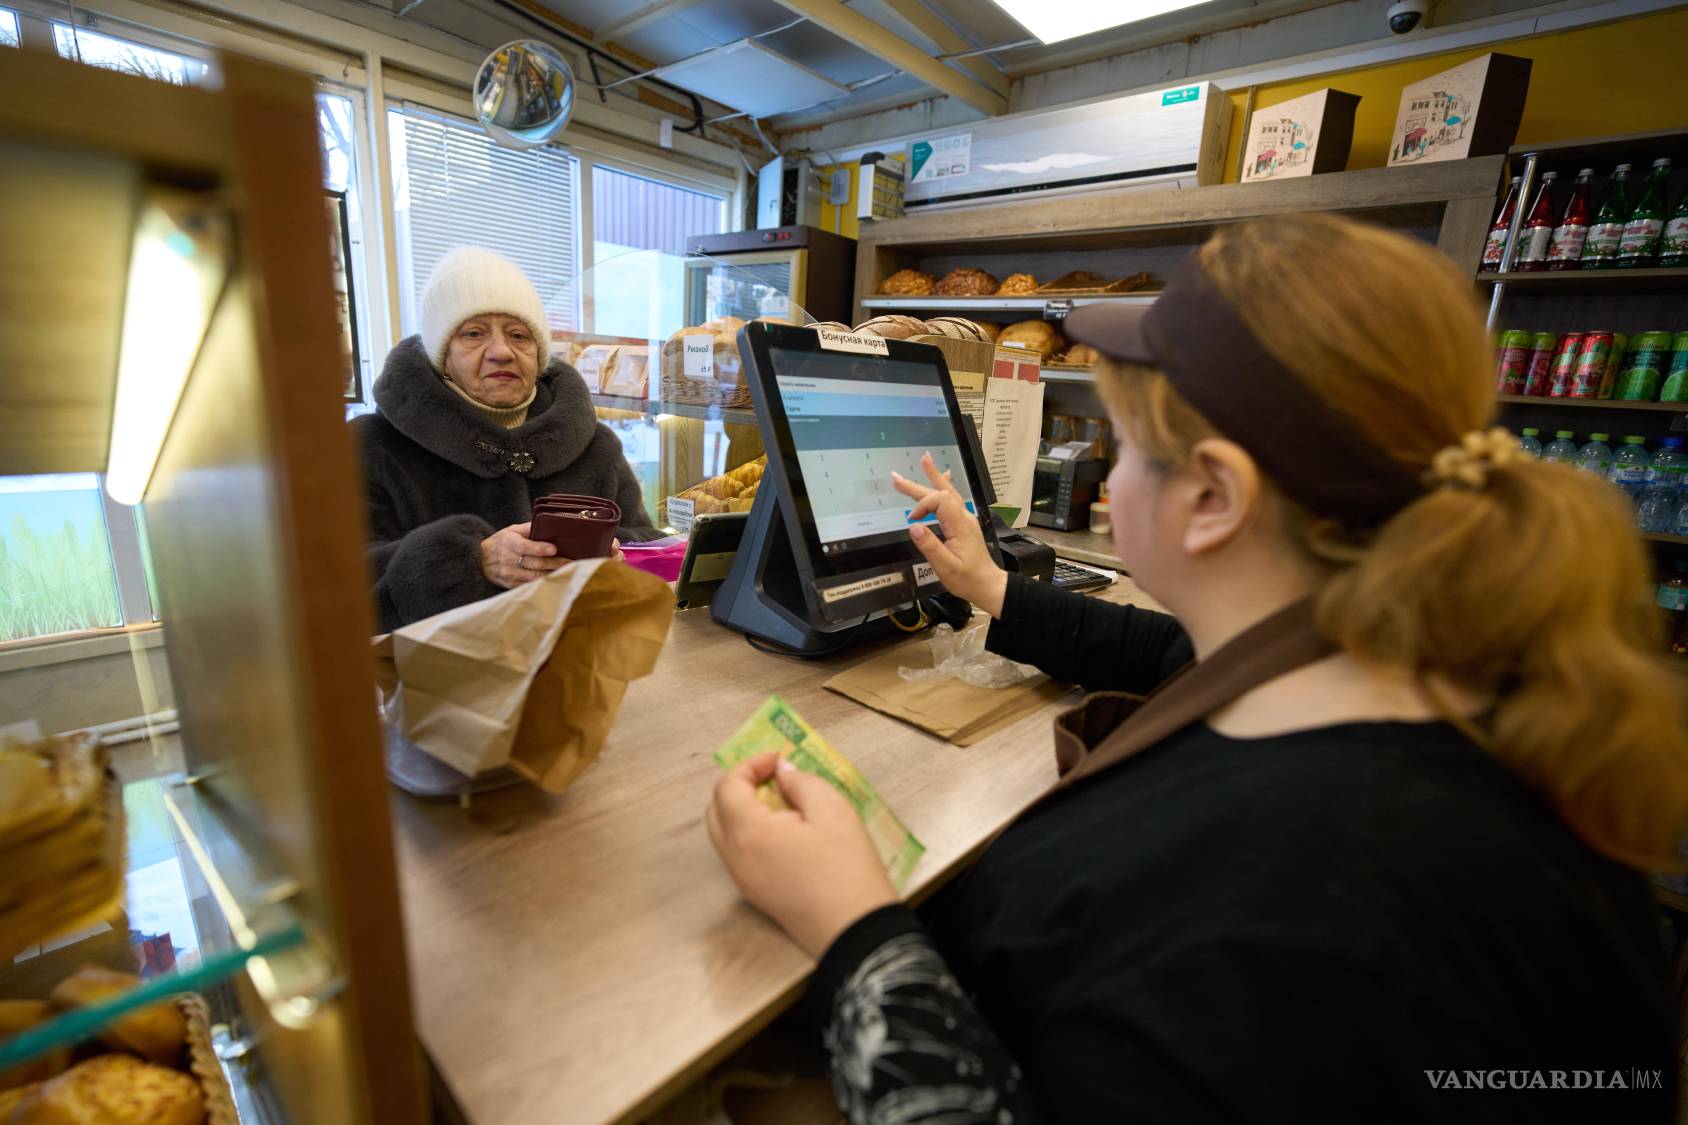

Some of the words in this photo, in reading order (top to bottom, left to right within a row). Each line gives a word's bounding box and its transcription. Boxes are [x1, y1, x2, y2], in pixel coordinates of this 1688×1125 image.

[820, 330, 862, 345] Бонусная
[864, 338, 886, 349] карта
[687, 344, 709, 353] Ржаной
